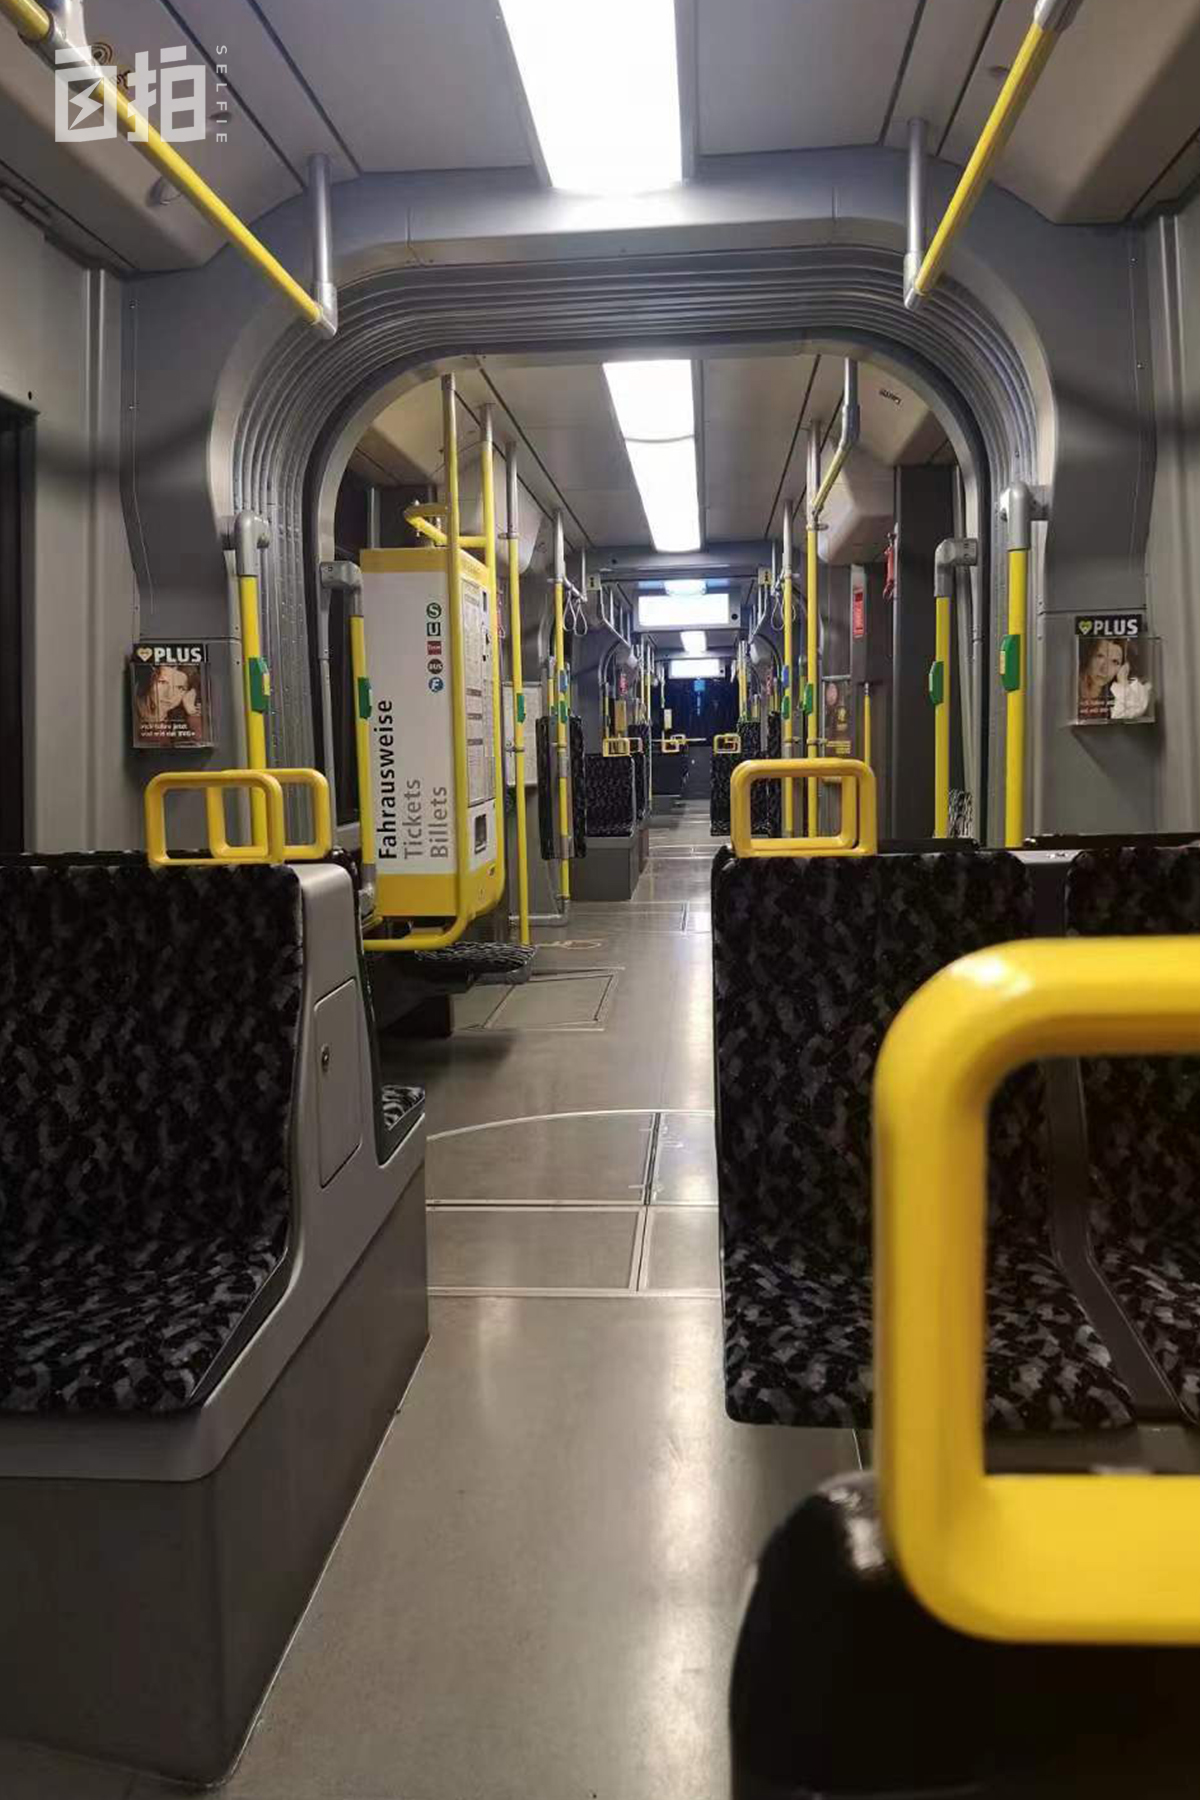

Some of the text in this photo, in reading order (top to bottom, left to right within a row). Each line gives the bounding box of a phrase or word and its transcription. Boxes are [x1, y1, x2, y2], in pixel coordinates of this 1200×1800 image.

[428, 603, 441, 617] S
[428, 622, 440, 636] U
[1093, 618, 1139, 636] PLUS
[153, 646, 202, 664] PLUS
[430, 678, 442, 691] F
[374, 700, 397, 859] Fahrausweise
[402, 778, 423, 860] Tickets
[428, 786, 449, 858] Billets
